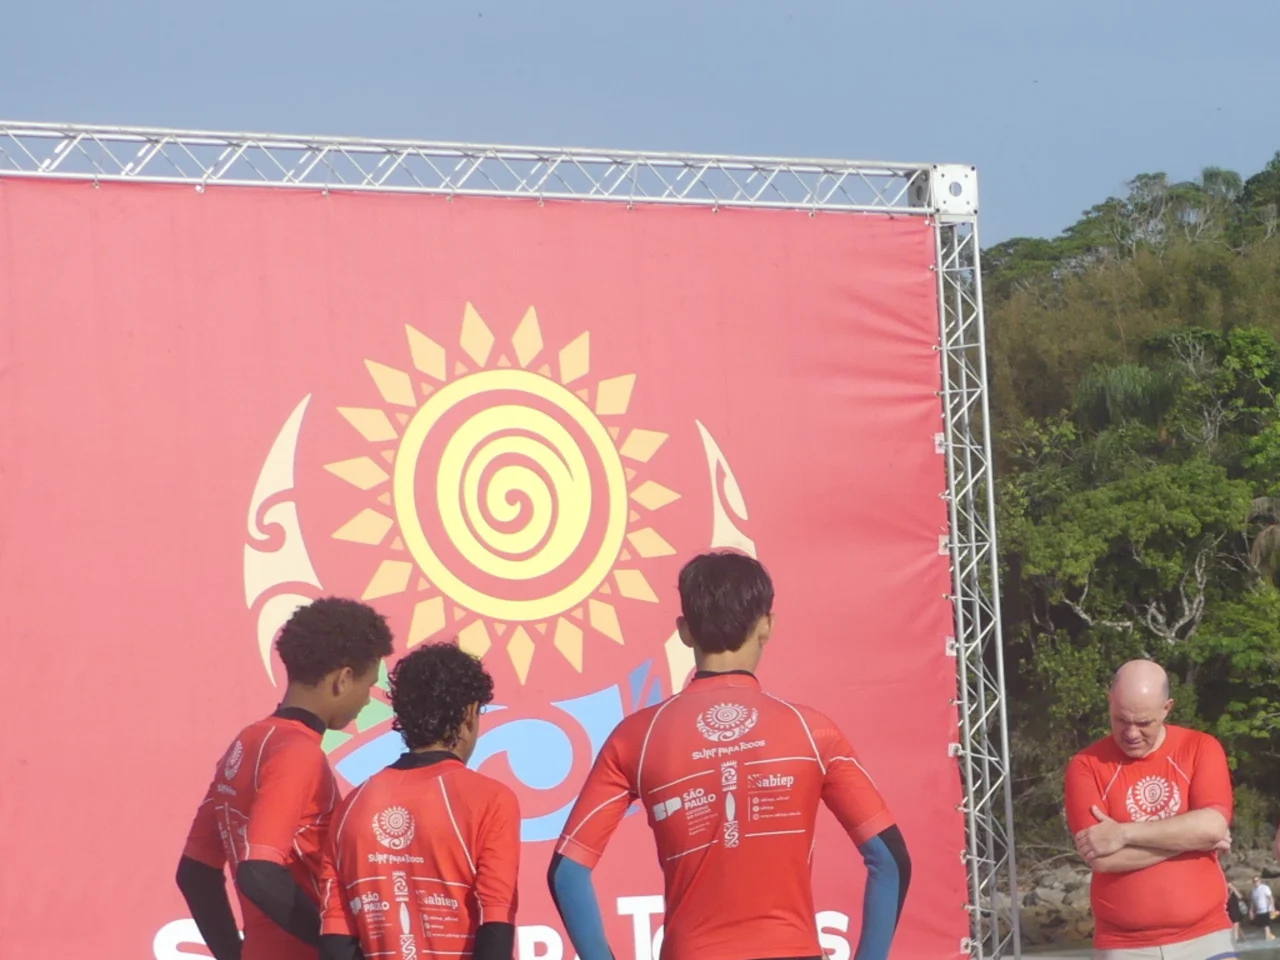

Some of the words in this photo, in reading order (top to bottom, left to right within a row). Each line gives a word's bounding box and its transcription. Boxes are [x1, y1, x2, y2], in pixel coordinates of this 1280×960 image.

[692, 748, 716, 760] SURF
[718, 745, 740, 757] PARA
[683, 788, 705, 802] SÃO
[684, 793, 717, 810] PAULO
